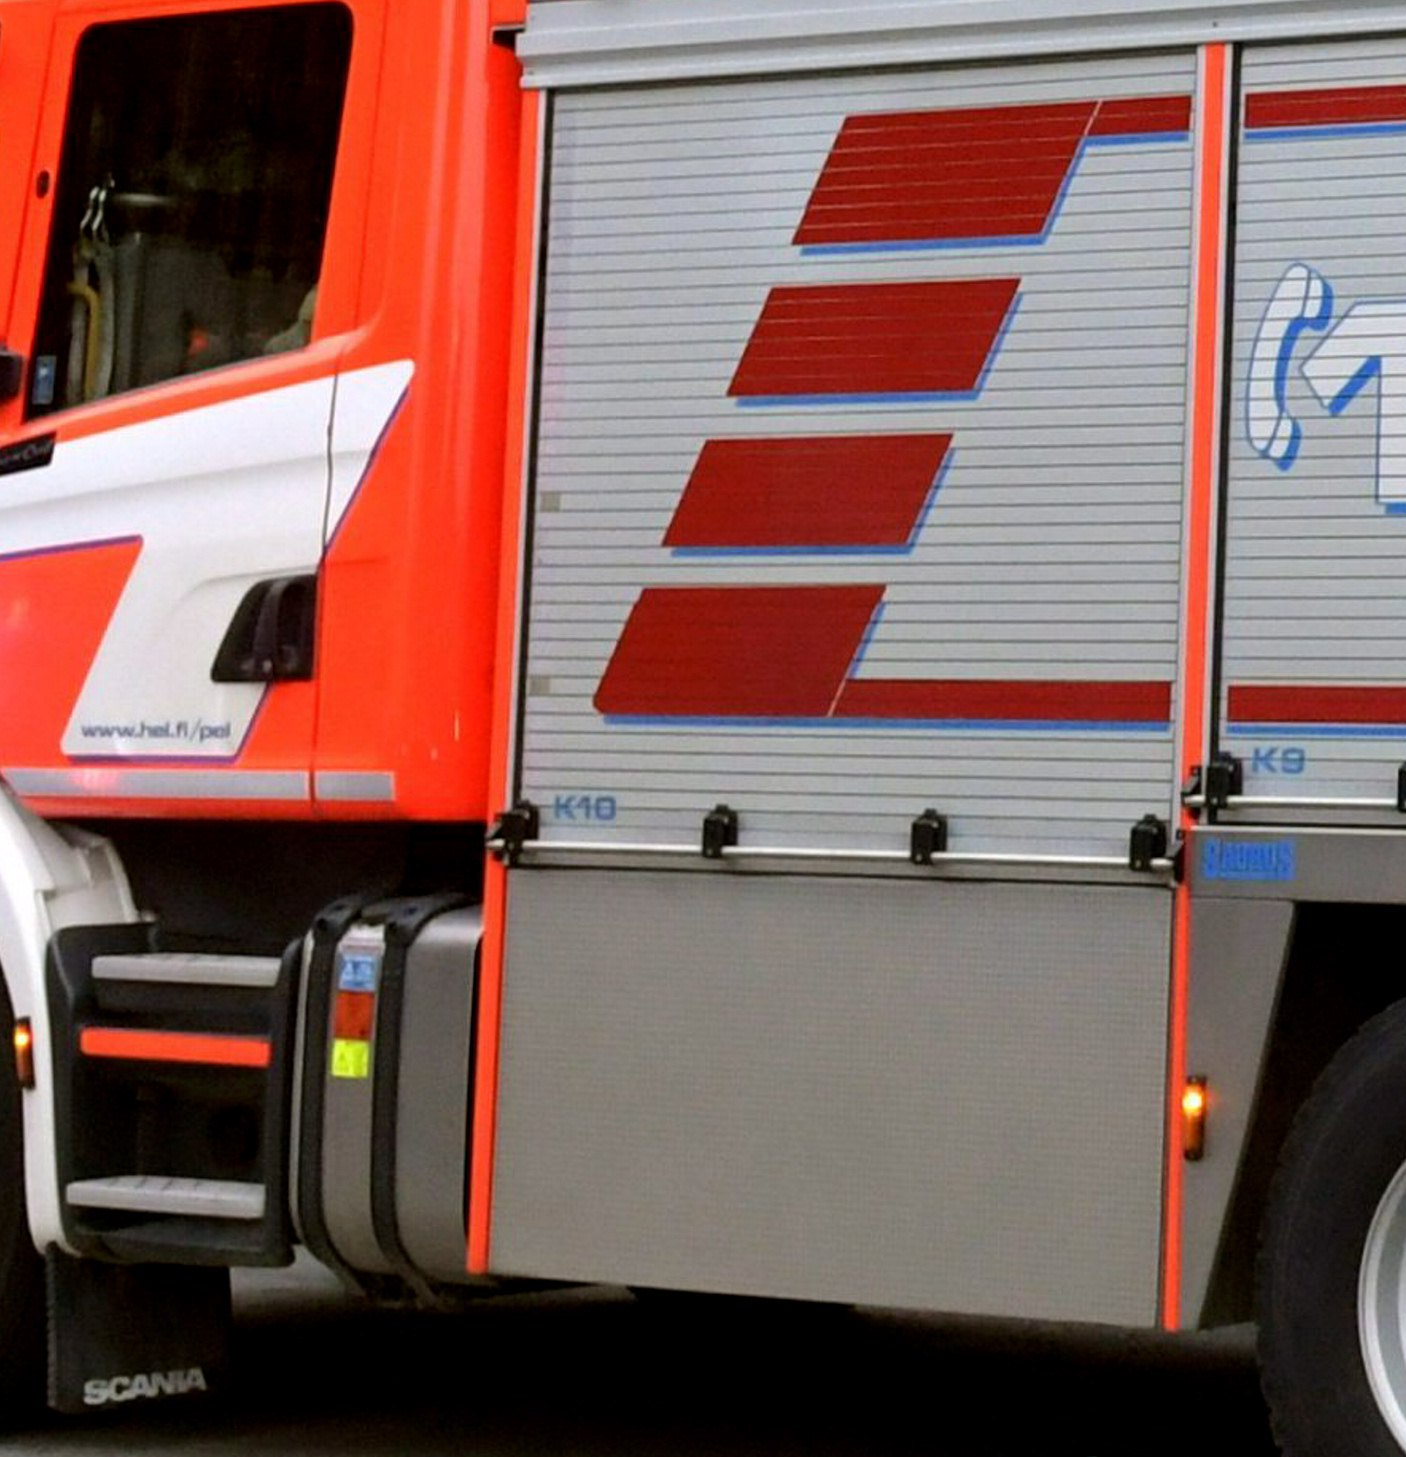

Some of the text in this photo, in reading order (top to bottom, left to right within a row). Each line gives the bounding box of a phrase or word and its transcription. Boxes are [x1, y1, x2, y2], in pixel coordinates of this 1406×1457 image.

[81, 719, 231, 742] www.hel.fi/pel
[1252, 747, 1306, 774] K9
[554, 794, 617, 821] K10
[83, 1367, 207, 1405] SCANIA
